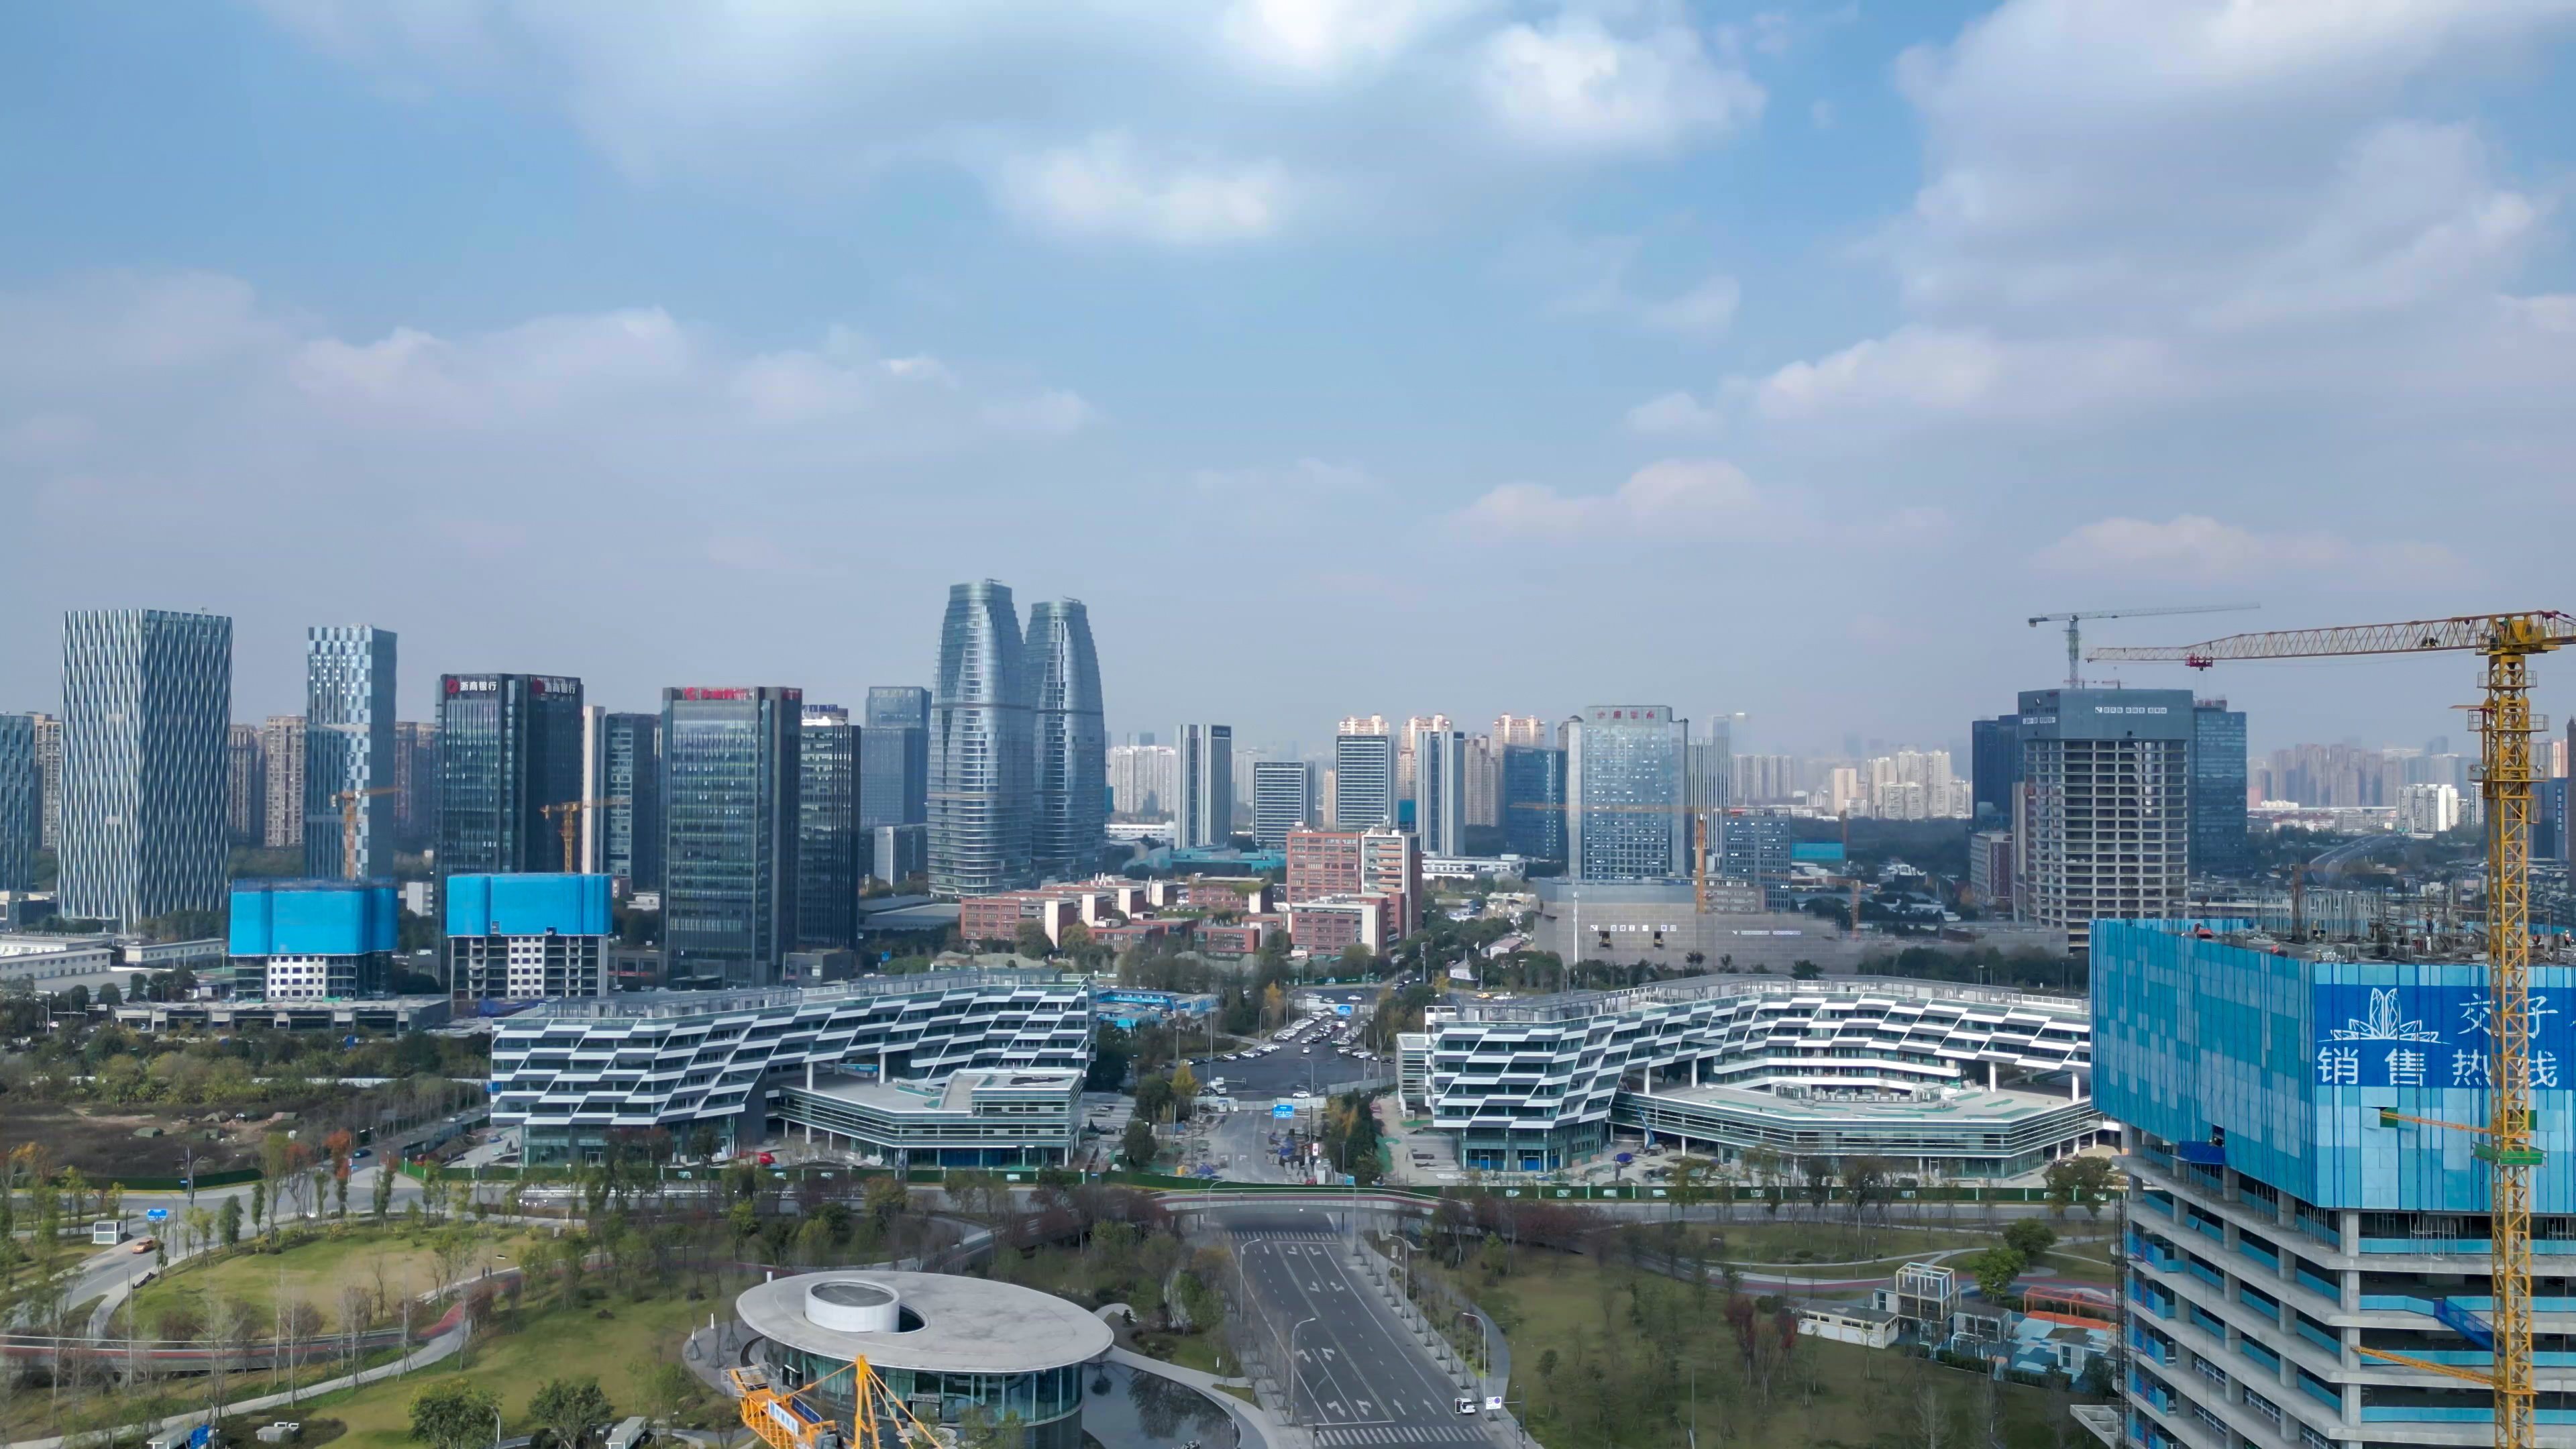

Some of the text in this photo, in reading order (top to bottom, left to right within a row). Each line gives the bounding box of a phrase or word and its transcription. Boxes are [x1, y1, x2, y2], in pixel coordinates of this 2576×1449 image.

[460, 681, 497, 692] 浙商银行
[2317, 1046, 2558, 1088] 销售热线
